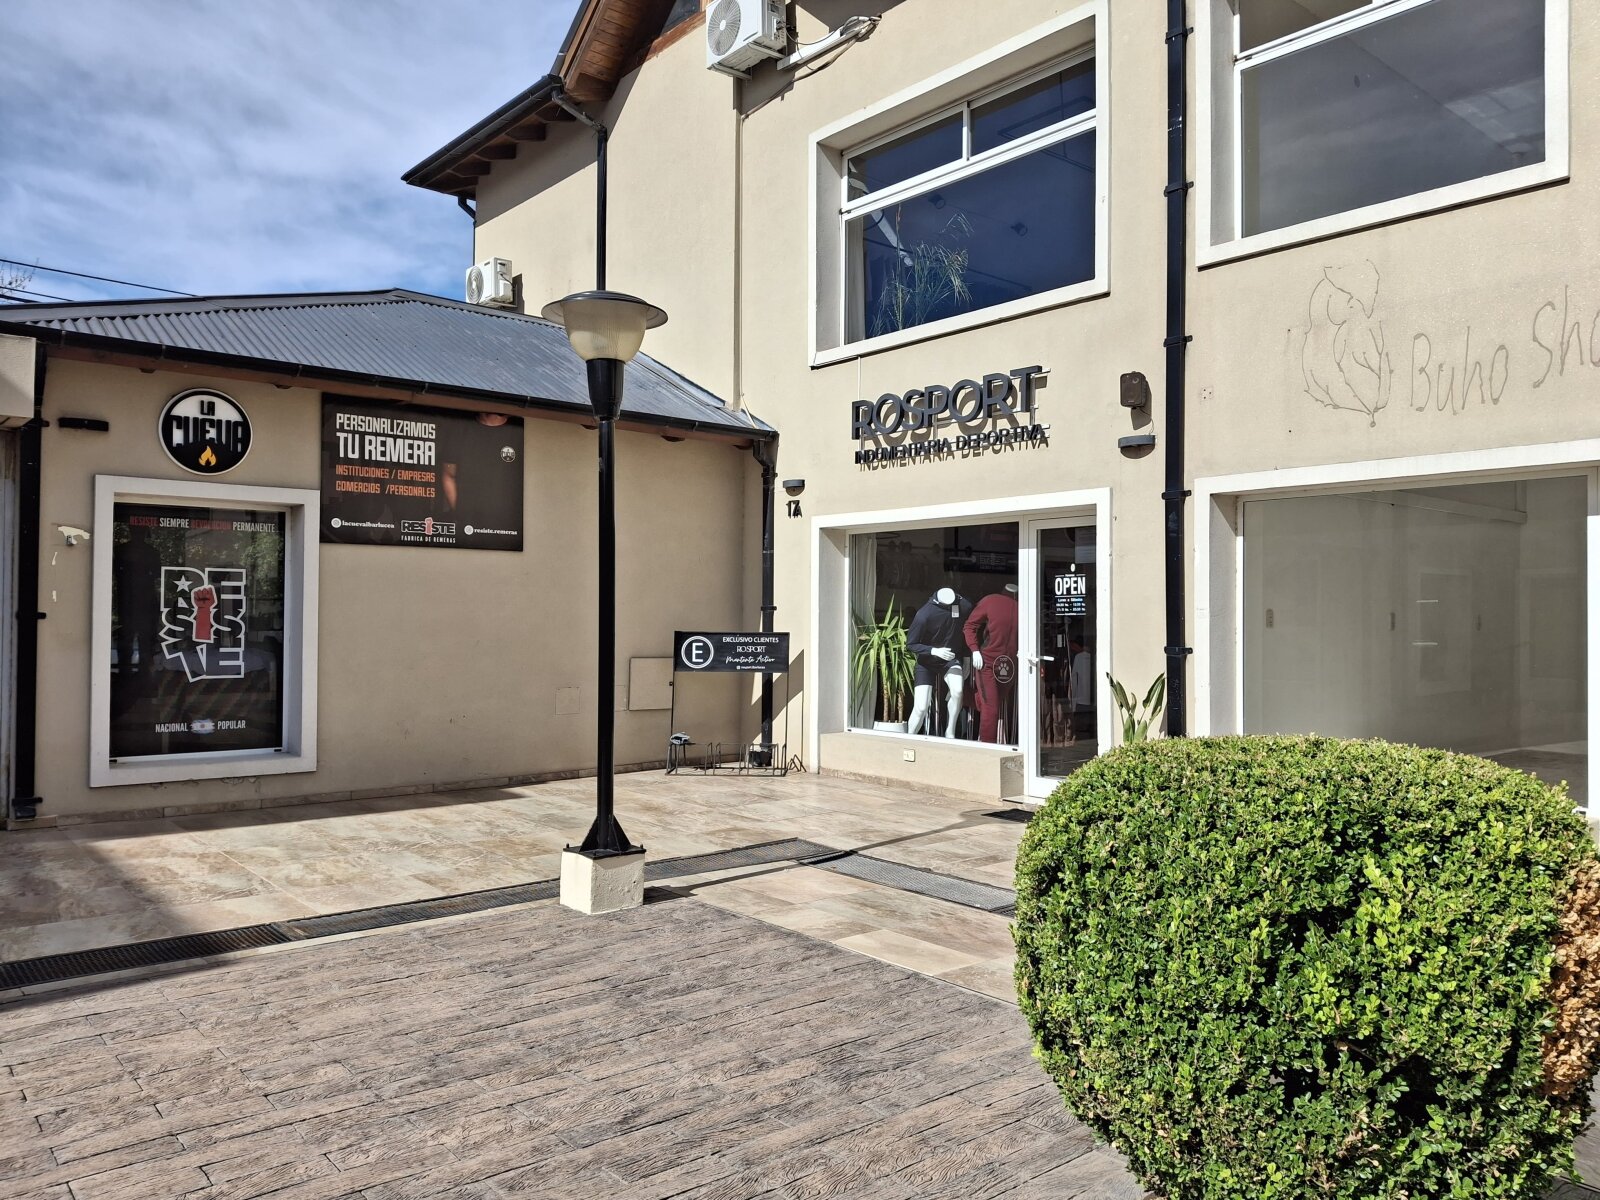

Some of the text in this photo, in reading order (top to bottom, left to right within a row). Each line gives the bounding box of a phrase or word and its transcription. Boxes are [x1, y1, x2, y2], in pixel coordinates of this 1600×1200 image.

[1410, 326, 1509, 416] Buho
[200, 400, 215, 416] LA
[851, 365, 1043, 440] ROSPORT
[336, 413, 436, 439] PERSONALIZAMOS
[336, 432, 436, 466] TU REMERA
[855, 423, 1045, 464] INDUMENTARIA DEPORTIVA
[336, 465, 389, 478] INSTITUCIONES
[397, 469, 436, 483] EMPRESAS
[336, 481, 380, 494] COMERCIOS
[159, 517, 190, 528] SIEMPRE
[232, 521, 276, 532] PERMANENTE
[401, 517, 456, 535] RESISTE
[433, 536, 456, 544] REMERAS
[1054, 576, 1086, 595] OPEN
[691, 642, 704, 662] E
[736, 645, 767, 653] ROSPORT
[155, 719, 246, 733] NACIONAL POPULAR
